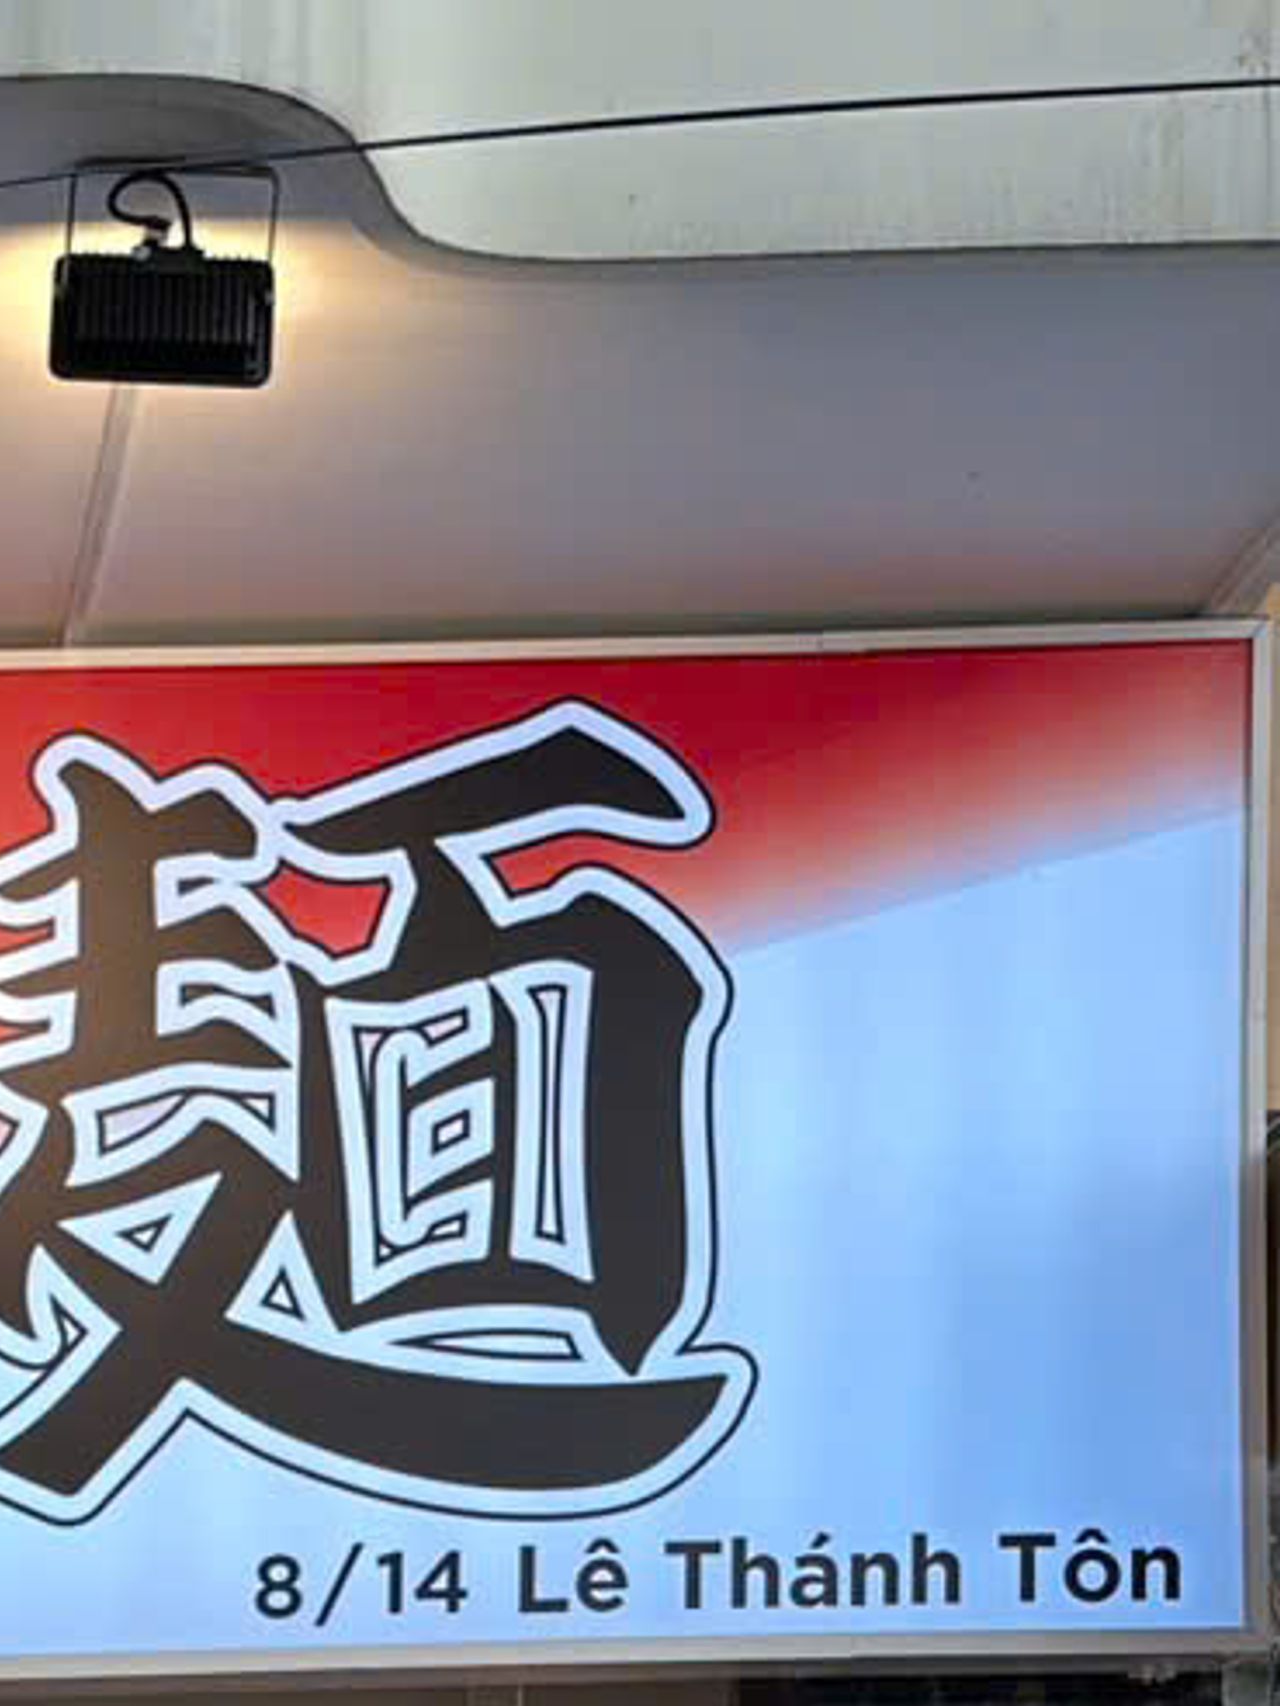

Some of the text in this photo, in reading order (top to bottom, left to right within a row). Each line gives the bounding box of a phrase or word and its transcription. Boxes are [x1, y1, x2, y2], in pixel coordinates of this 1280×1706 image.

[255, 1527, 1181, 1628] 8/14 Lê Thánh Tôn
